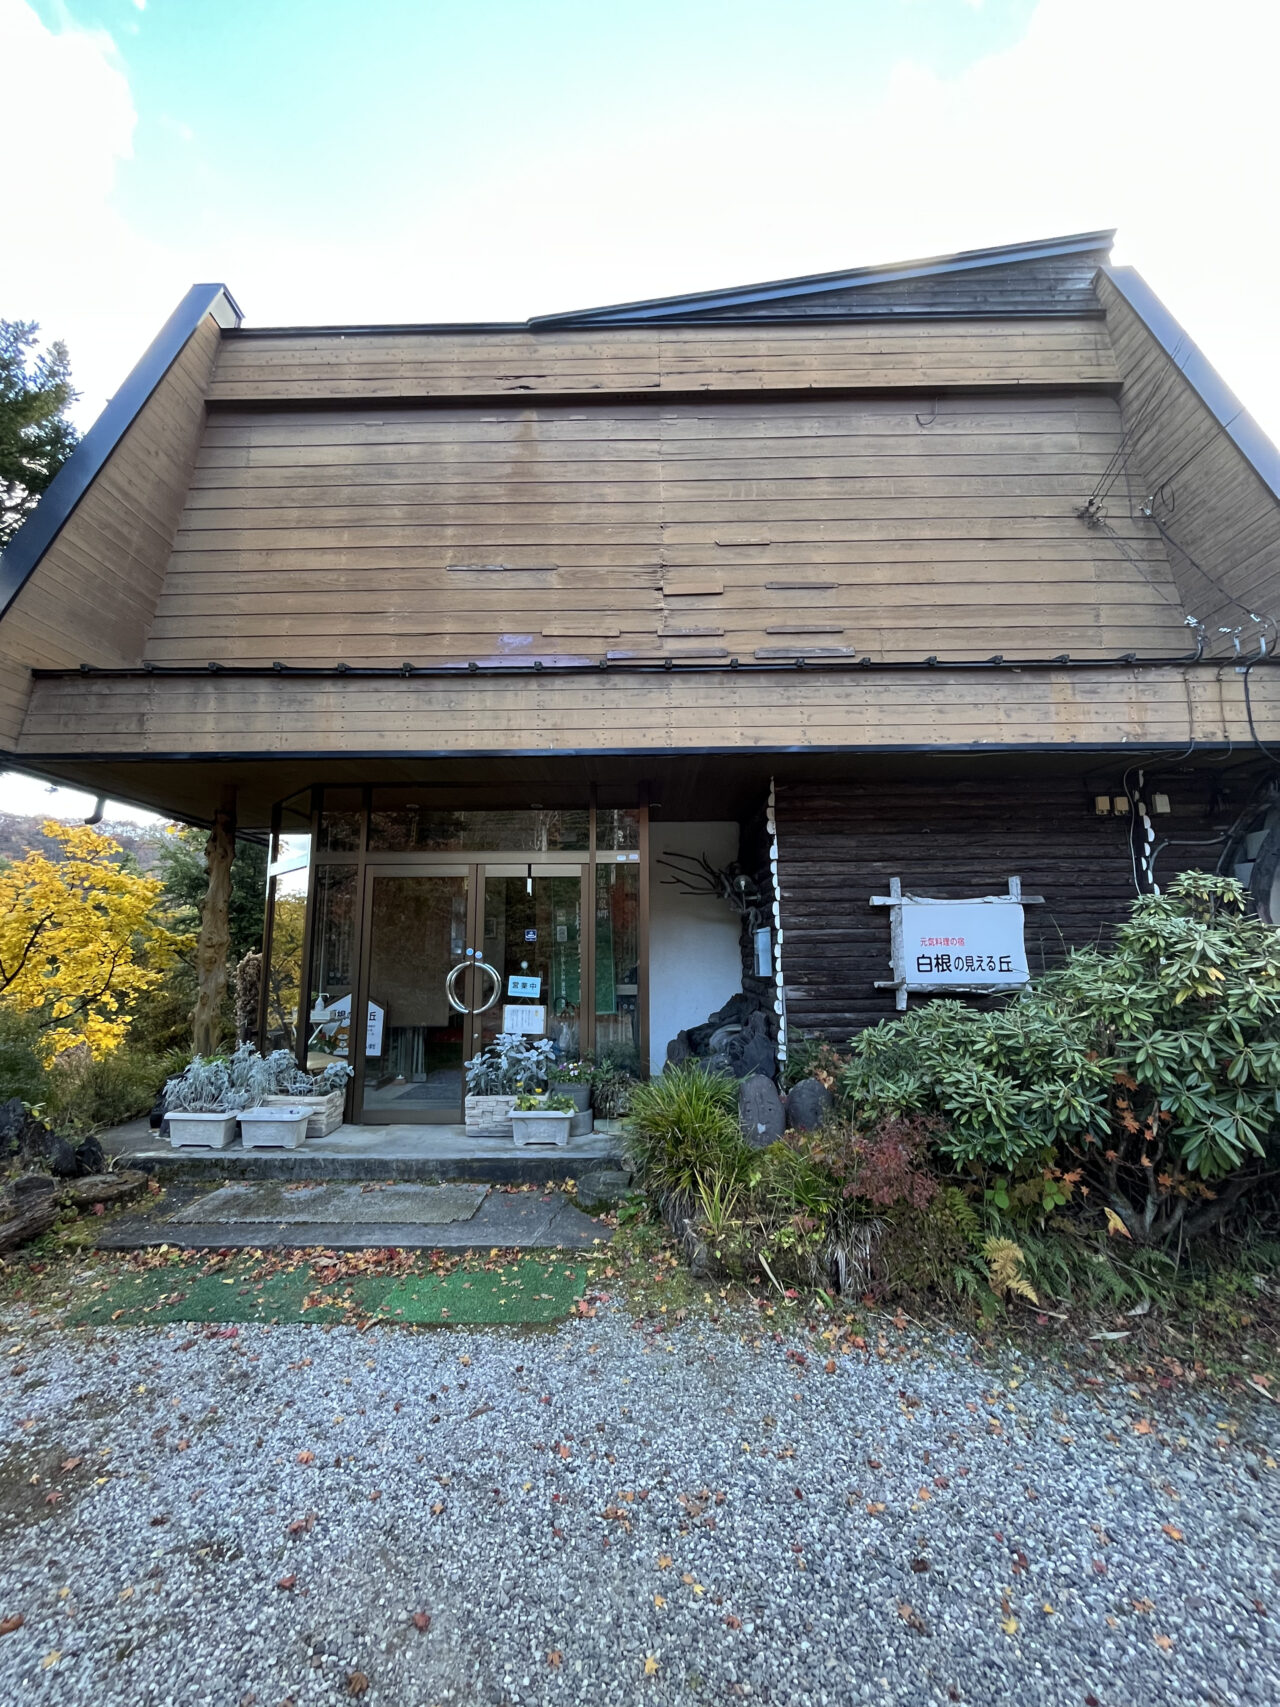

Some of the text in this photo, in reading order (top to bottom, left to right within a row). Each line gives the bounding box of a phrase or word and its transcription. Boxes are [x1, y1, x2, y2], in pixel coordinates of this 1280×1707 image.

[920, 937, 965, 947] 元気料理の宿
[916, 953, 1014, 973] 白根の見える丘
